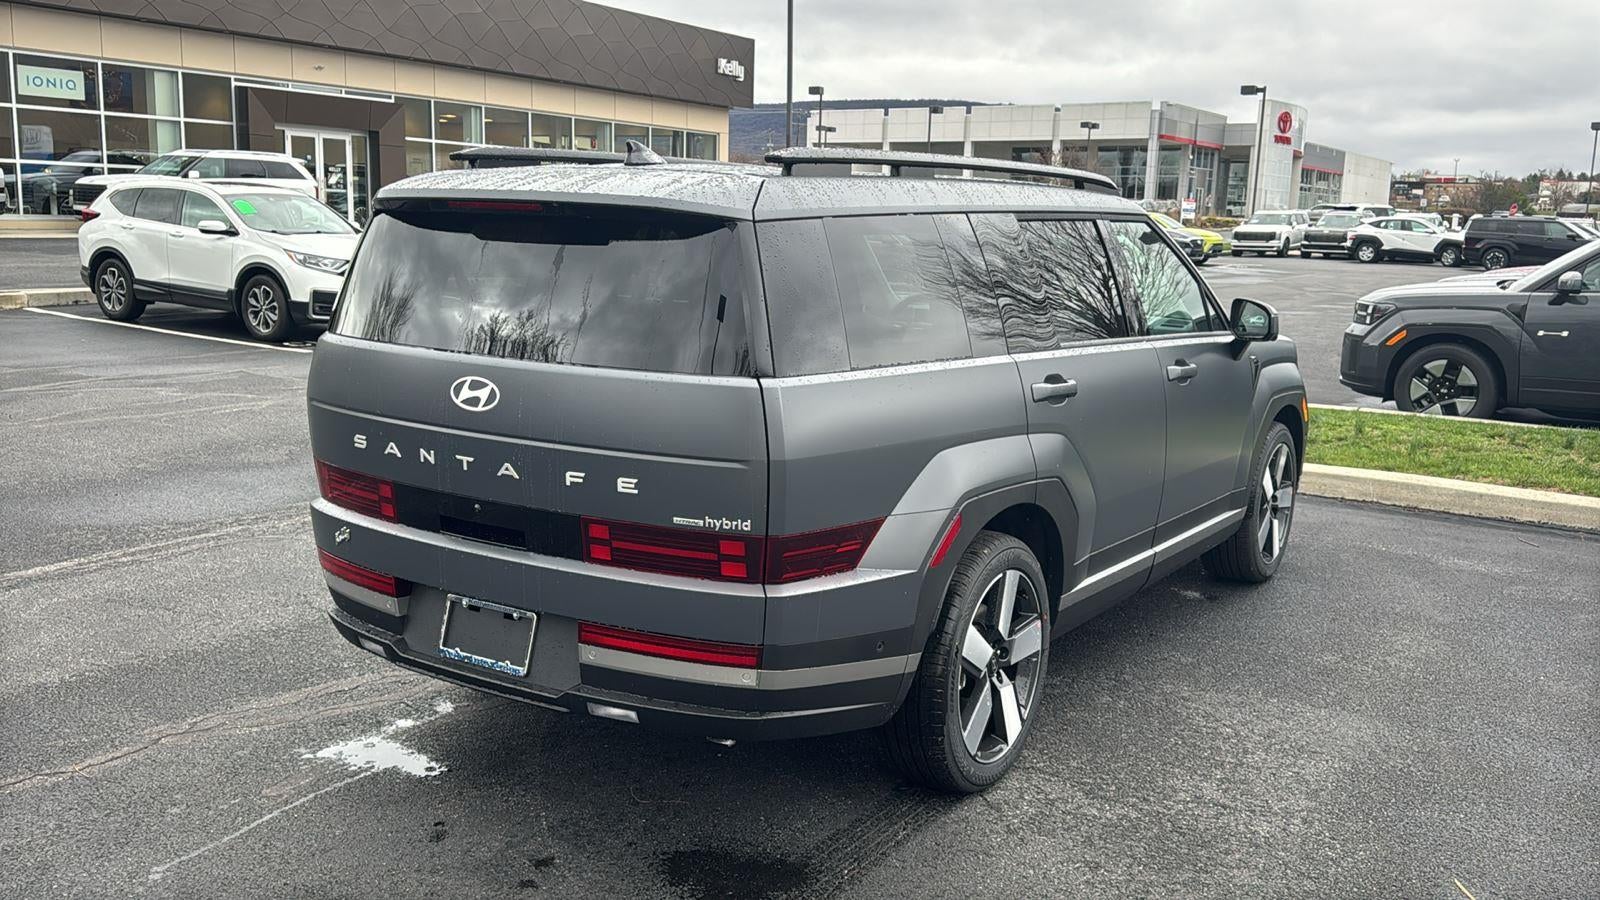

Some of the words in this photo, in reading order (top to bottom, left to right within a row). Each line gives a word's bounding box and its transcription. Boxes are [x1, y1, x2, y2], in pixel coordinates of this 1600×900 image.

[717, 58, 745, 81] Kelly
[26, 75, 77, 91] IONIQ
[353, 433, 519, 480] SANTA
[565, 471, 639, 494] FE
[704, 515, 751, 531] hybrid
